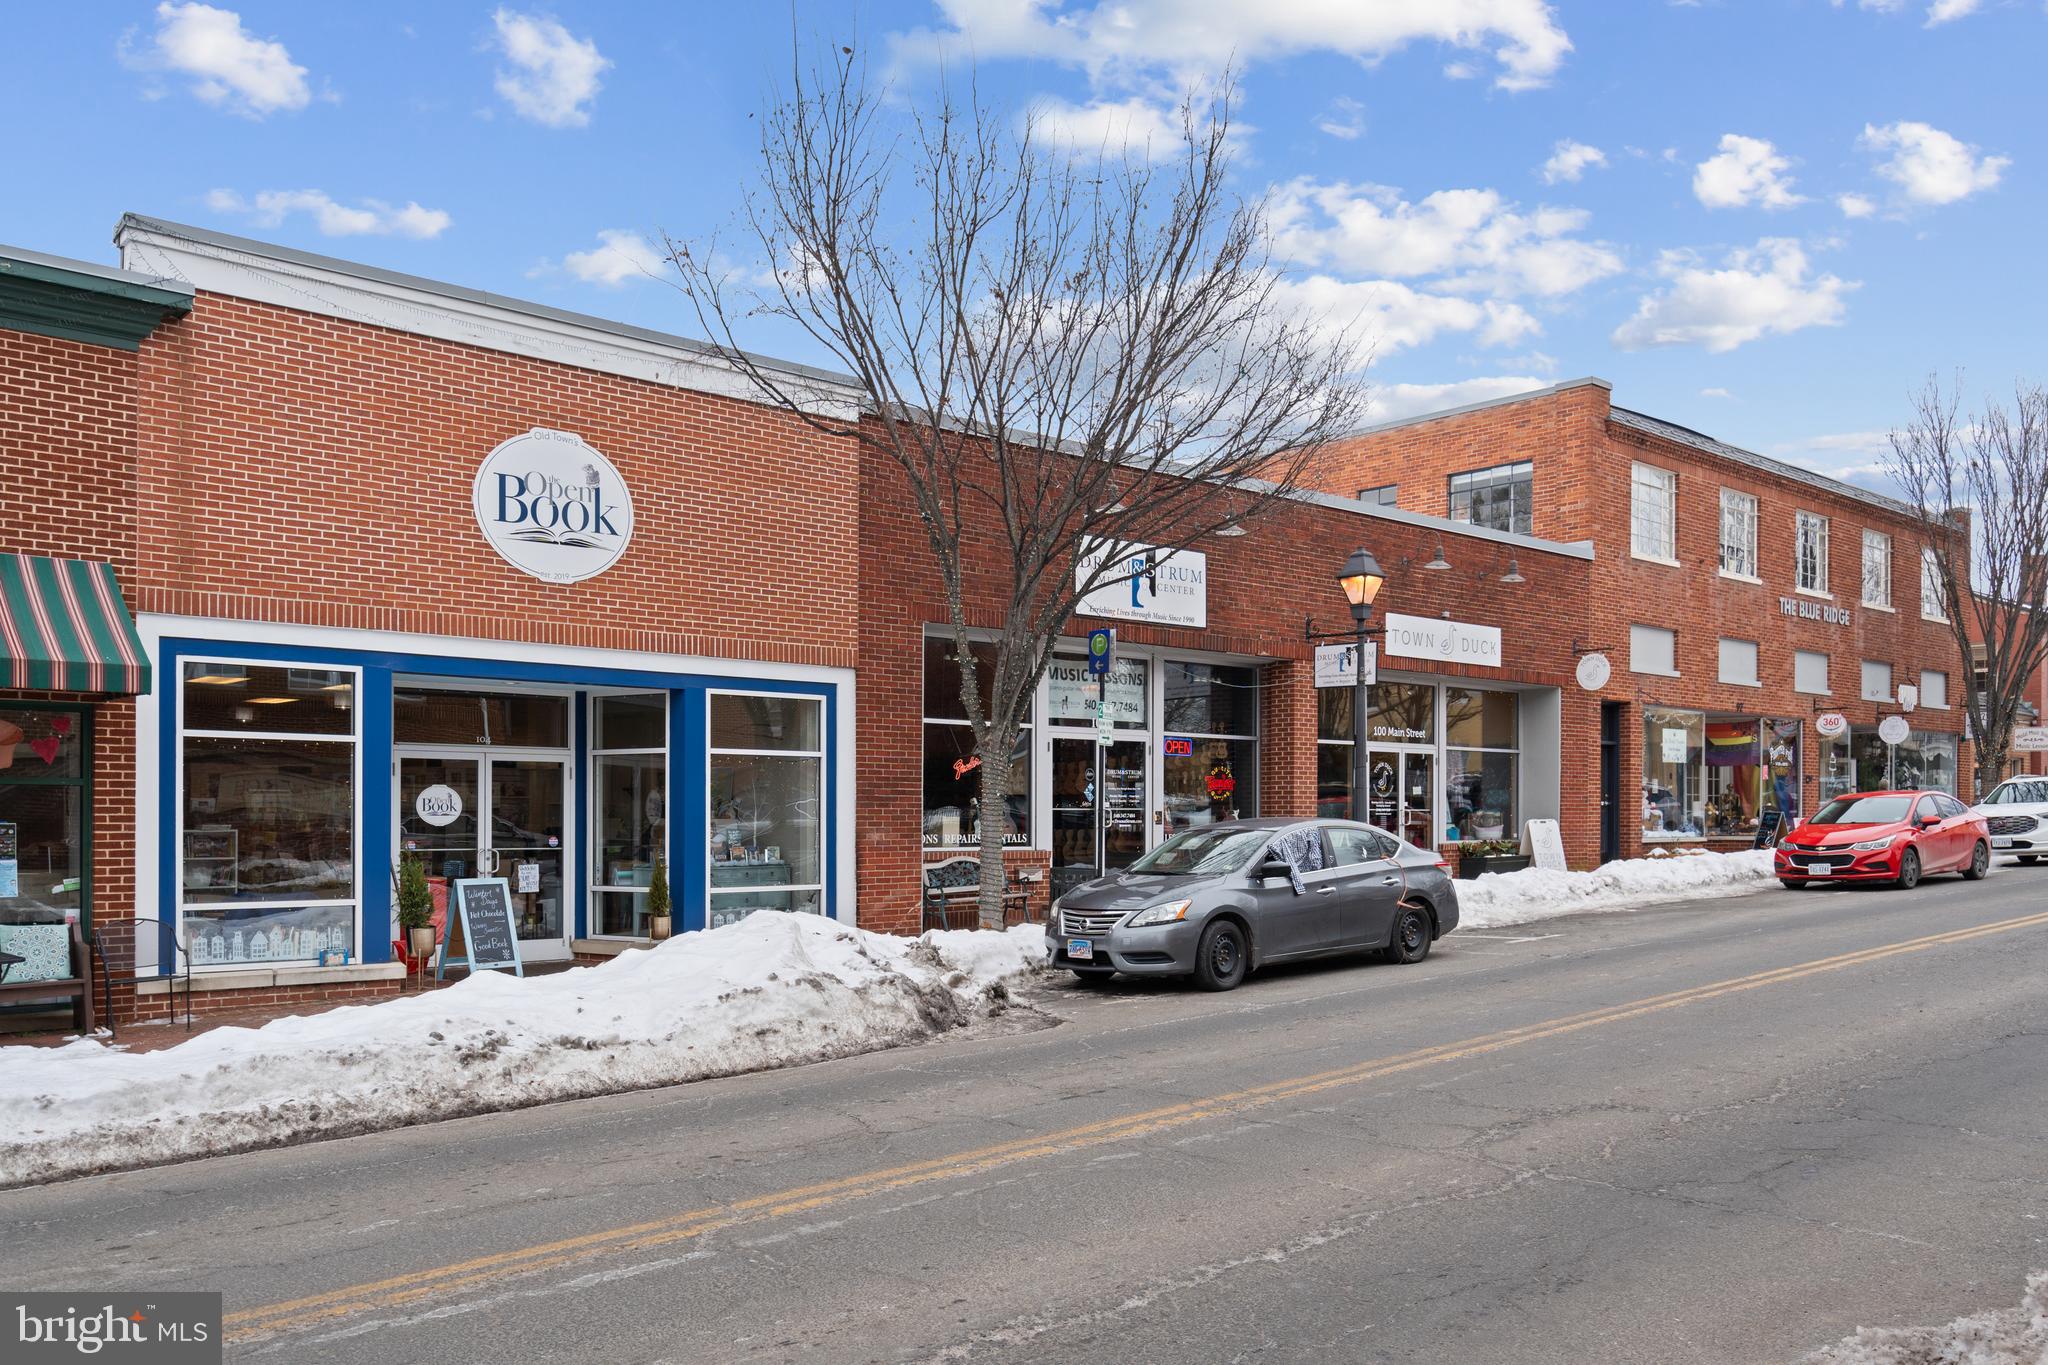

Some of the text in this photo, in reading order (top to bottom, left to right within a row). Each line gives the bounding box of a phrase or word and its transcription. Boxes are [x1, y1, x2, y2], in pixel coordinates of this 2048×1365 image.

[534, 431, 579, 447] Old Town's
[524, 470, 594, 506] Open
[493, 472, 621, 536] Book
[554, 572, 570, 581] 2019
[1156, 583, 1195, 596] CENTER
[1116, 607, 1130, 617] Lives
[1131, 609, 1152, 619] through
[1152, 612, 1168, 620] Music
[1168, 614, 1182, 622] Since
[1779, 597, 1850, 626] THE BLUE RIDGE
[1392, 628, 1497, 656] TOWN DUCK
[1822, 717, 1840, 727] 360
[1373, 726, 1426, 739] 100 Main Street
[476, 736, 492, 745] 104
[1165, 740, 1191, 754] OPEN
[945, 833, 982, 844] REPAIRS
[470, 911, 481, 919] Hot
[474, 938, 509, 952] Good Book
